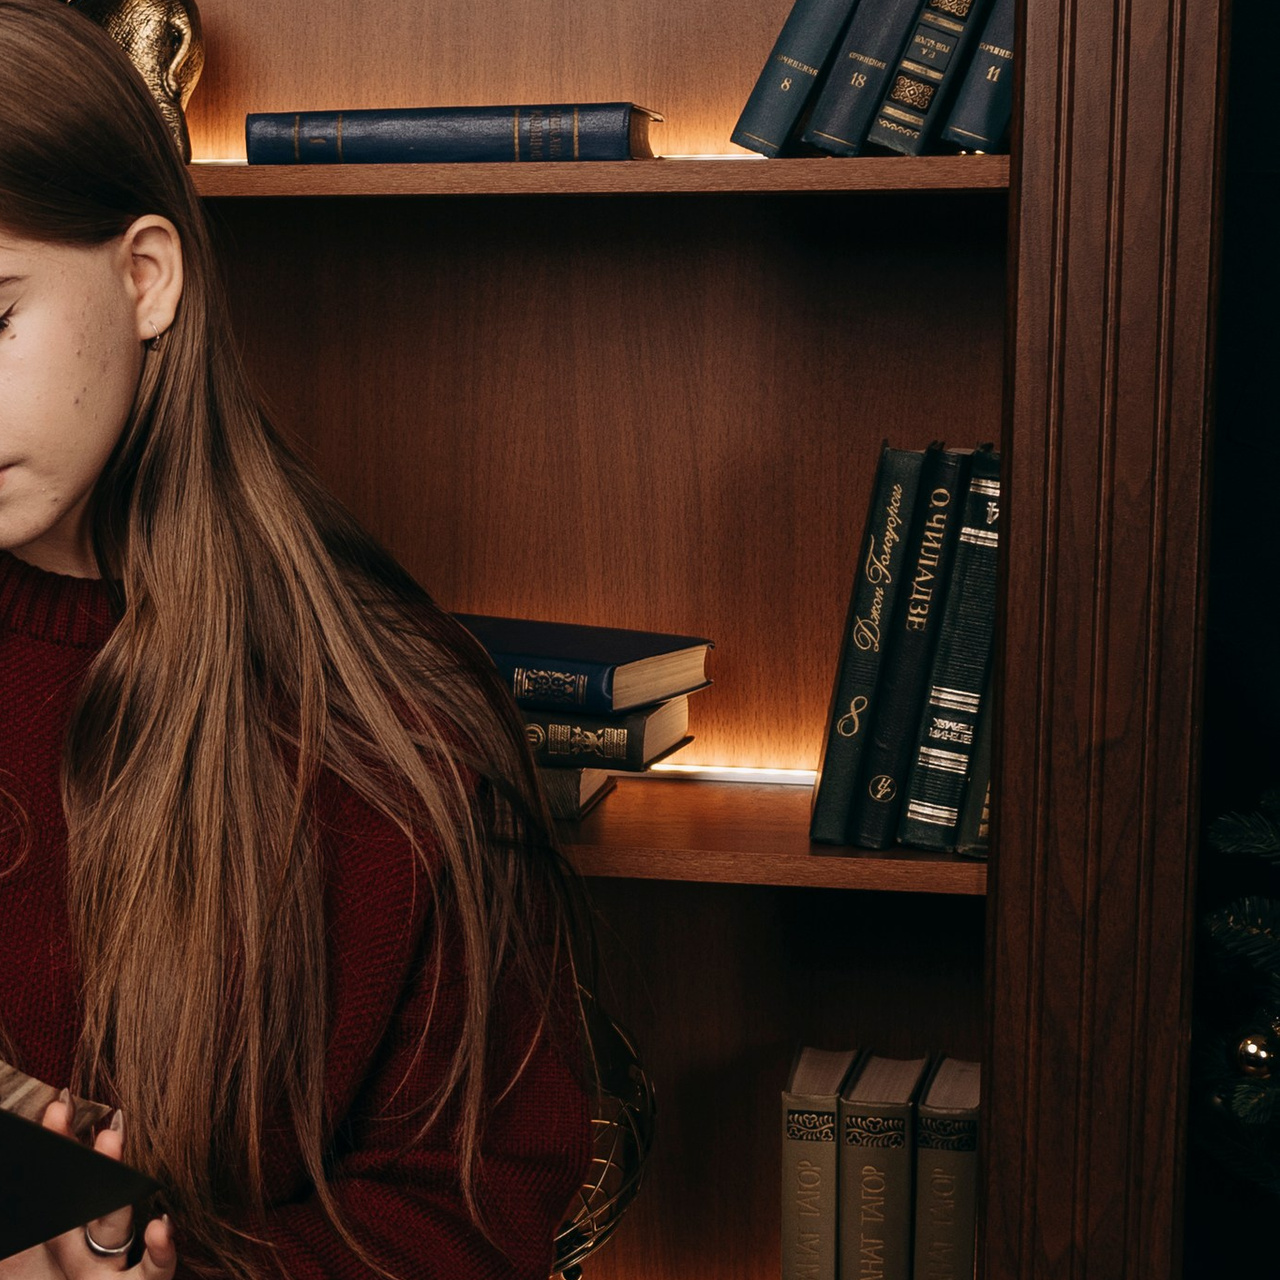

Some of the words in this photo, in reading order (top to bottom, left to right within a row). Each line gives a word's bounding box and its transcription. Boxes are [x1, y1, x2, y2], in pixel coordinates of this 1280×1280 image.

[780, 77, 793, 92] 8
[849, 71, 868, 89] 18
[985, 66, 1003, 83] 11
[865, 483, 903, 585] Голсуорси
[984, 501, 1000, 526] 4
[853, 584, 885, 653] Джон
[931, 716, 975, 735] ПЕРМЯК
[795, 1159, 822, 1219] ТАГОР
[860, 1164, 886, 1226] ТАГОР
[928, 1168, 956, 1226] ТАГОР
